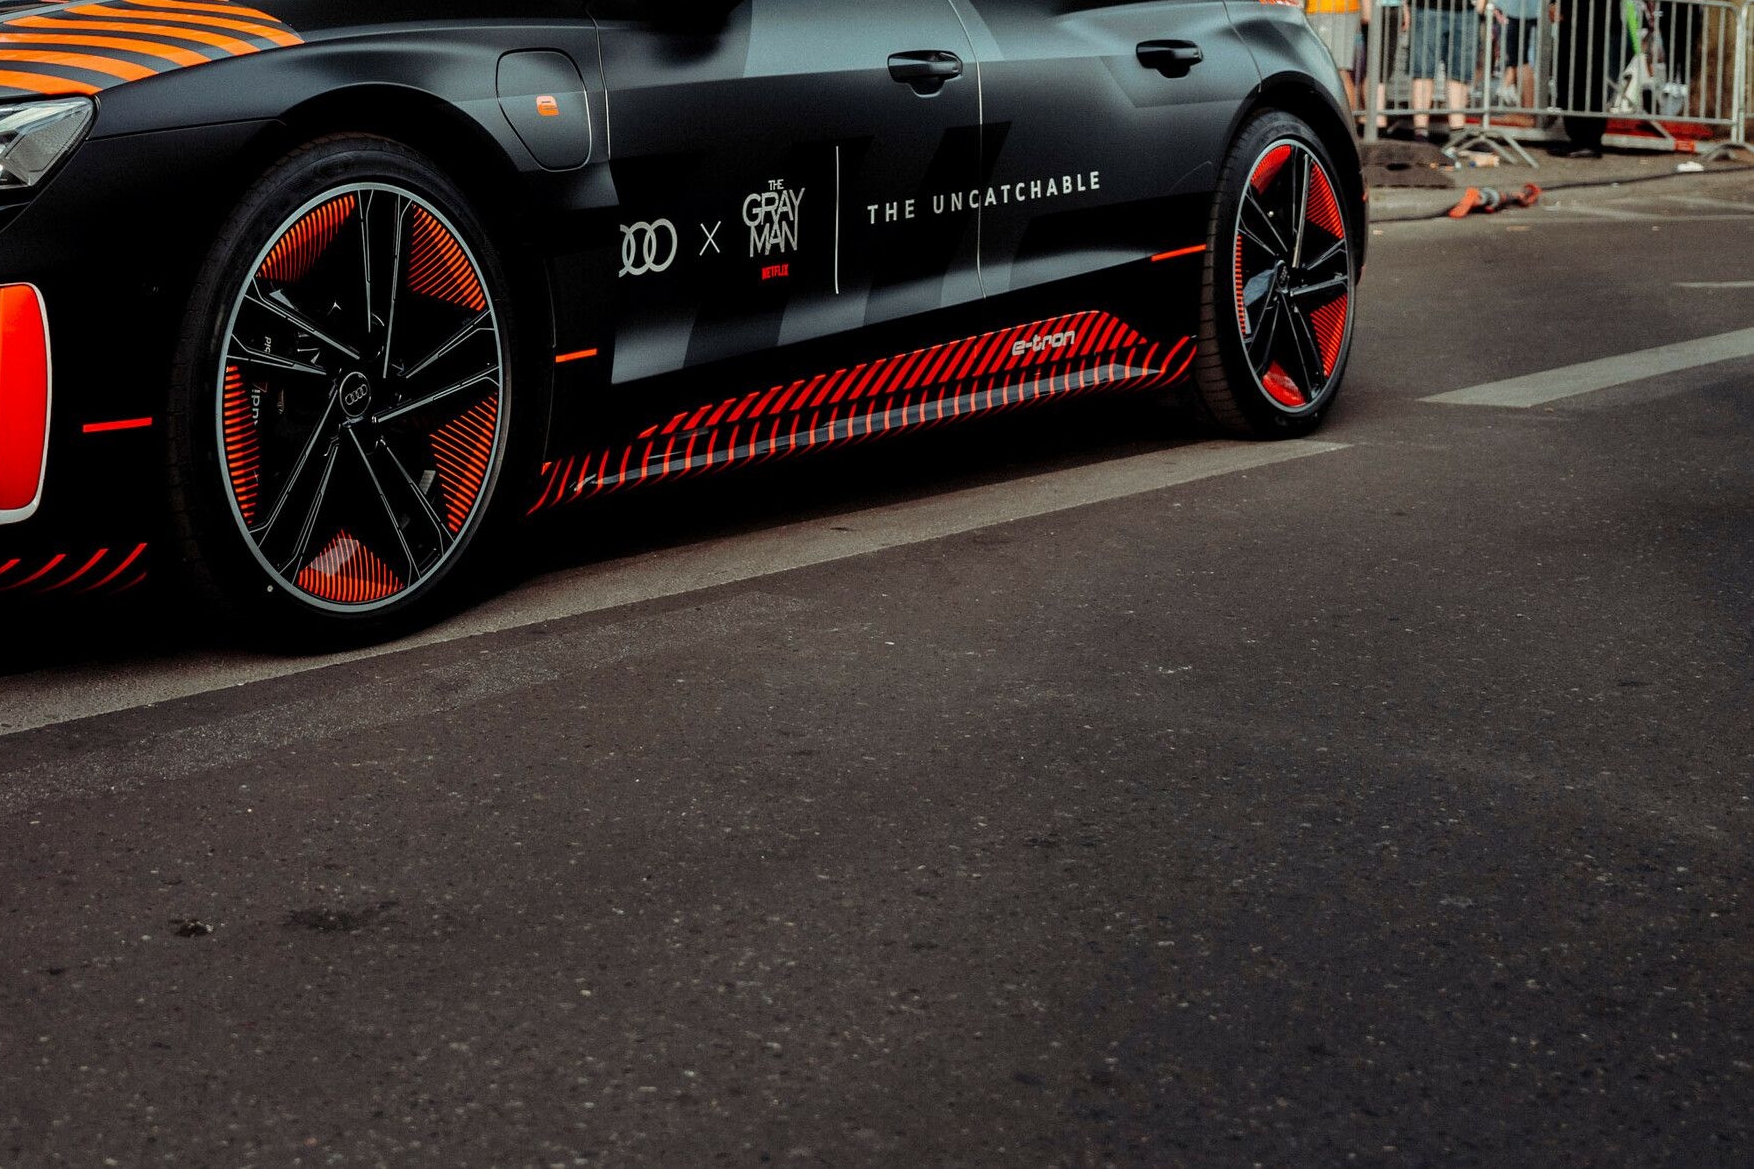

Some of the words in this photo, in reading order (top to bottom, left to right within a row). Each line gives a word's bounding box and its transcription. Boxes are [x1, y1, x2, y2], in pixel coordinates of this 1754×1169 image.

[742, 187, 806, 227] GRAY
[866, 198, 916, 225] THE
[932, 170, 1101, 215] UNCATCHABLE
[768, 178, 785, 191] THE
[749, 220, 799, 258] MAN
[761, 263, 789, 280] NETFLIX
[1011, 329, 1076, 356] e-tron
[250, 389, 261, 425] udi
